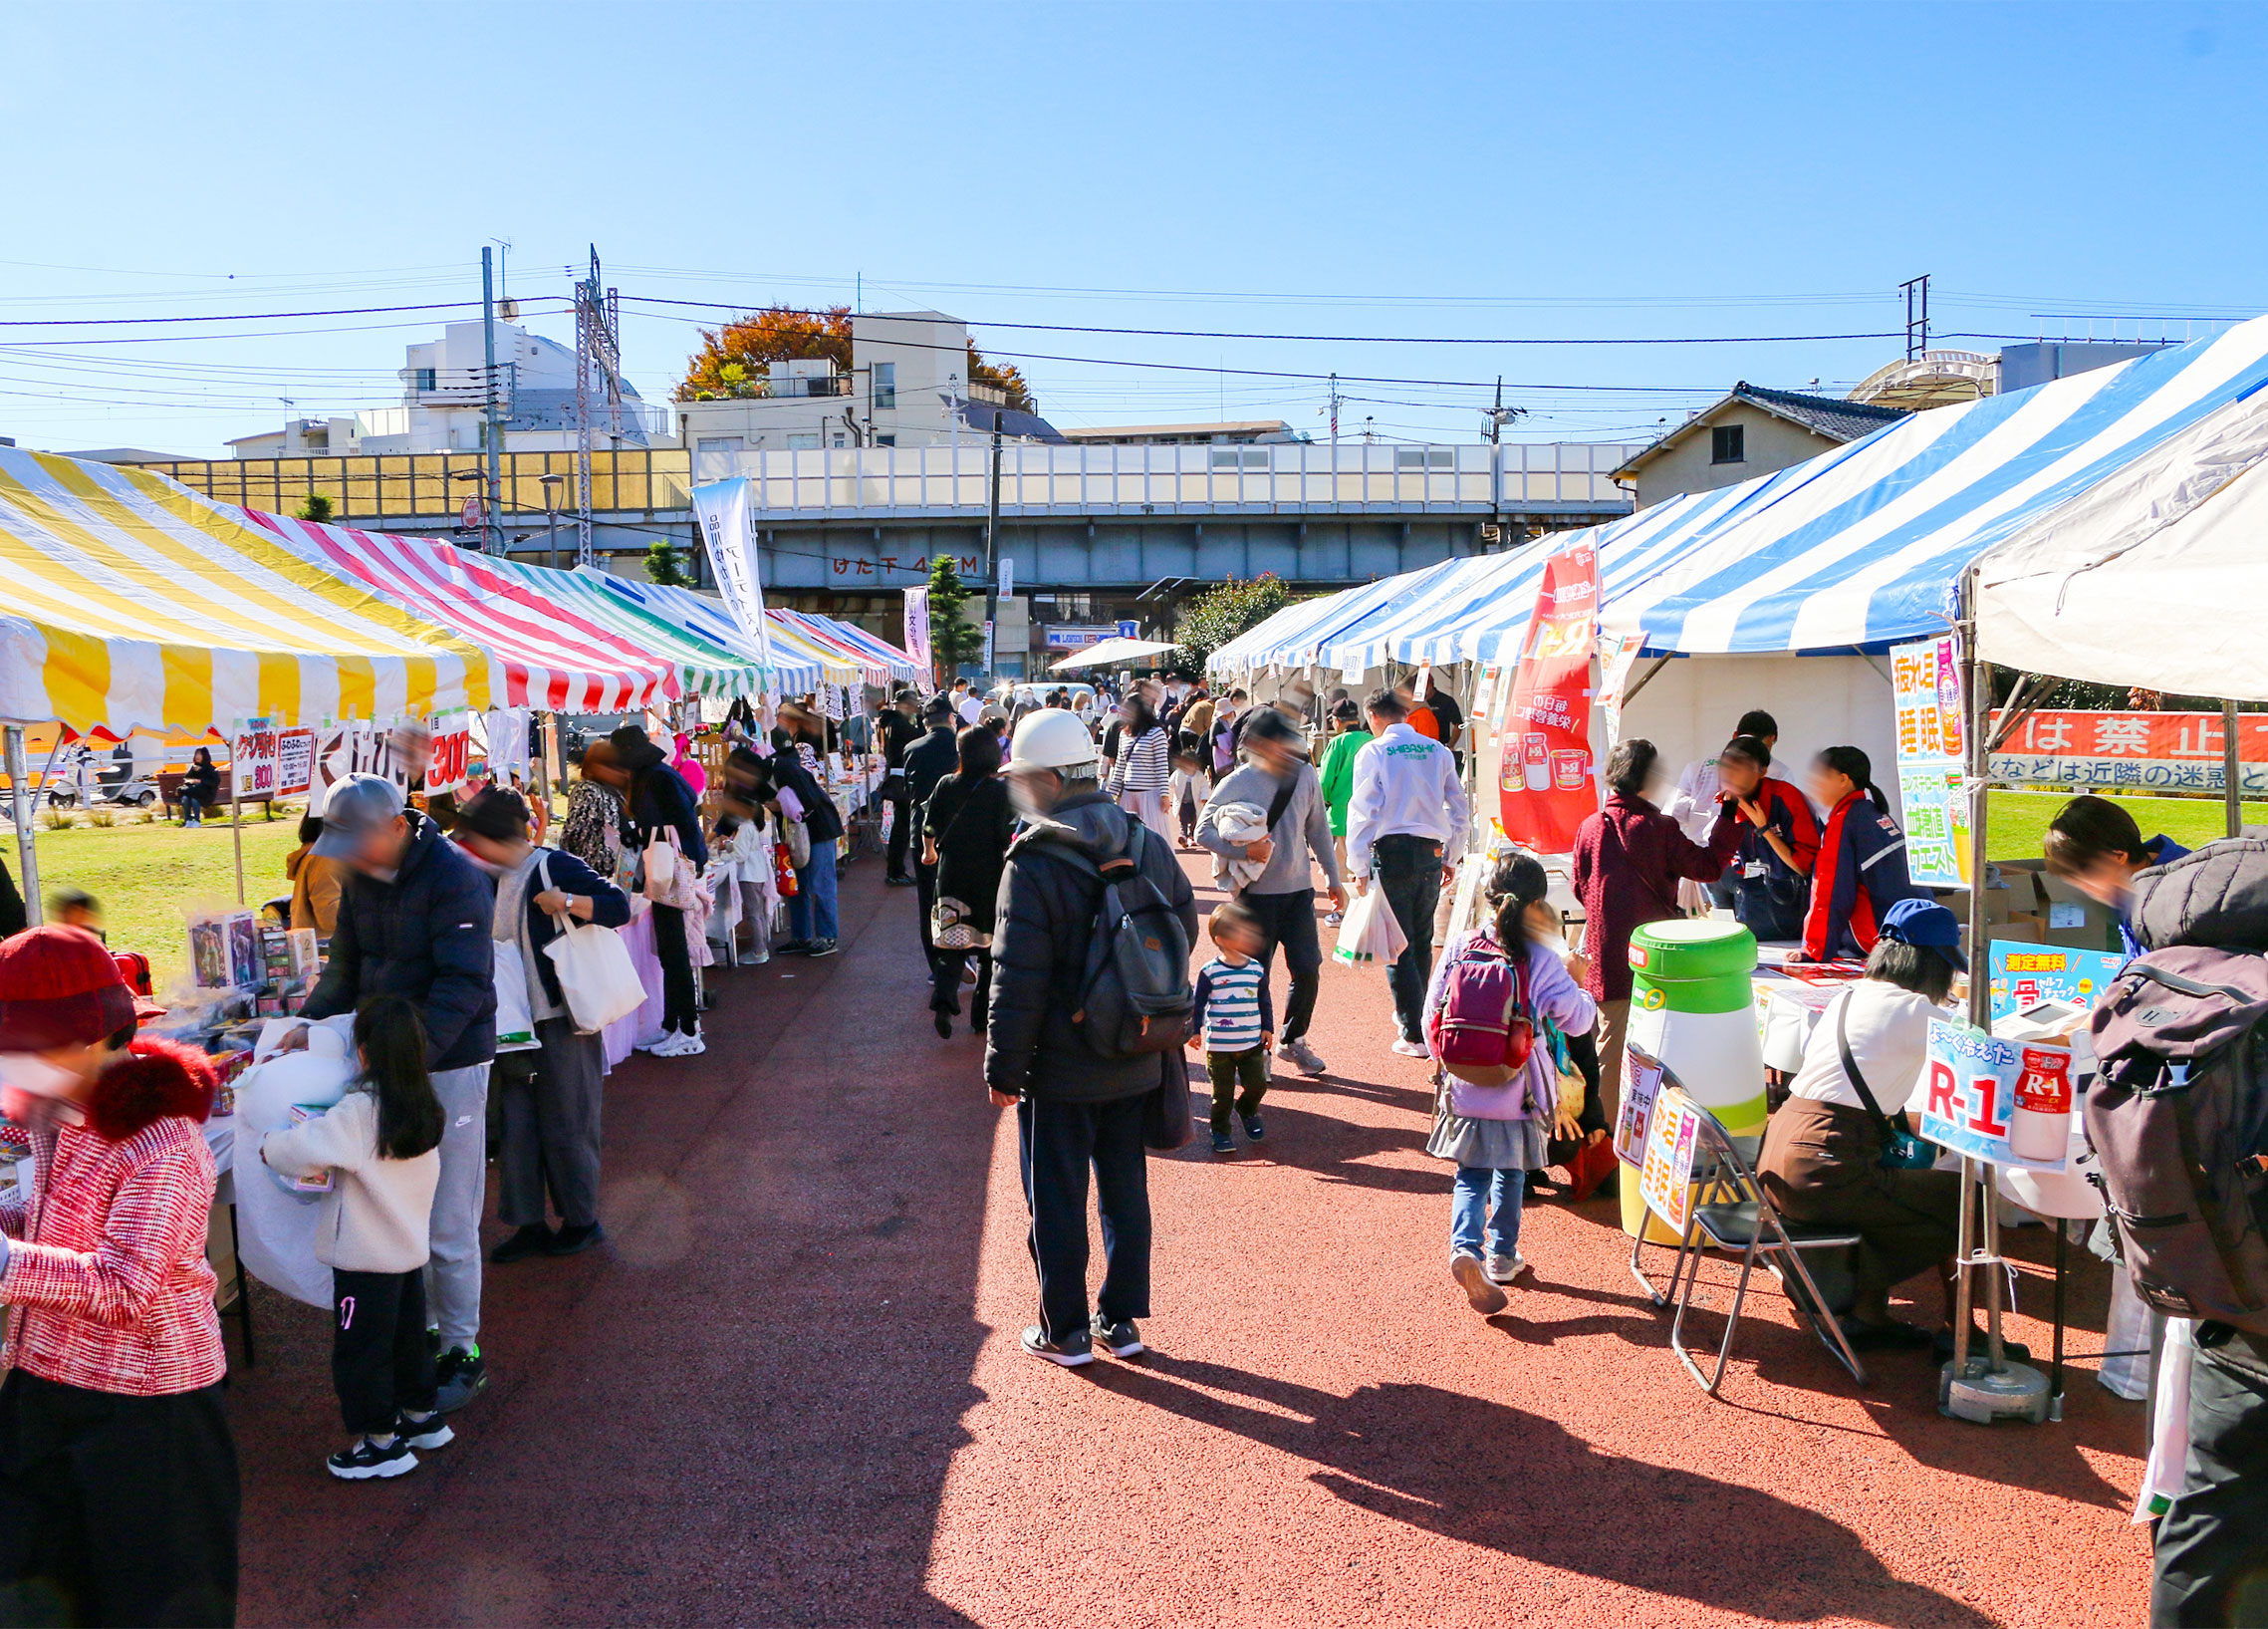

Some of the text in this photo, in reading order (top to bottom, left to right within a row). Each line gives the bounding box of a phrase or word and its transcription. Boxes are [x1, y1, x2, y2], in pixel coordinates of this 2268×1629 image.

[1894, 652, 1934, 693] 疲れ目
[1899, 707, 1940, 753] 睡眠
[428, 730, 468, 787] 300
[1901, 774, 1946, 793] コレステロール
[1908, 845, 1955, 874] ウエスト
[2006, 953, 2067, 972] 測定無料
[2038, 977, 2065, 988] セルフ
[2044, 984, 2075, 998] チェック
[2024, 1073, 2062, 1097] R-1
[1928, 1060, 2006, 1137] R-1
